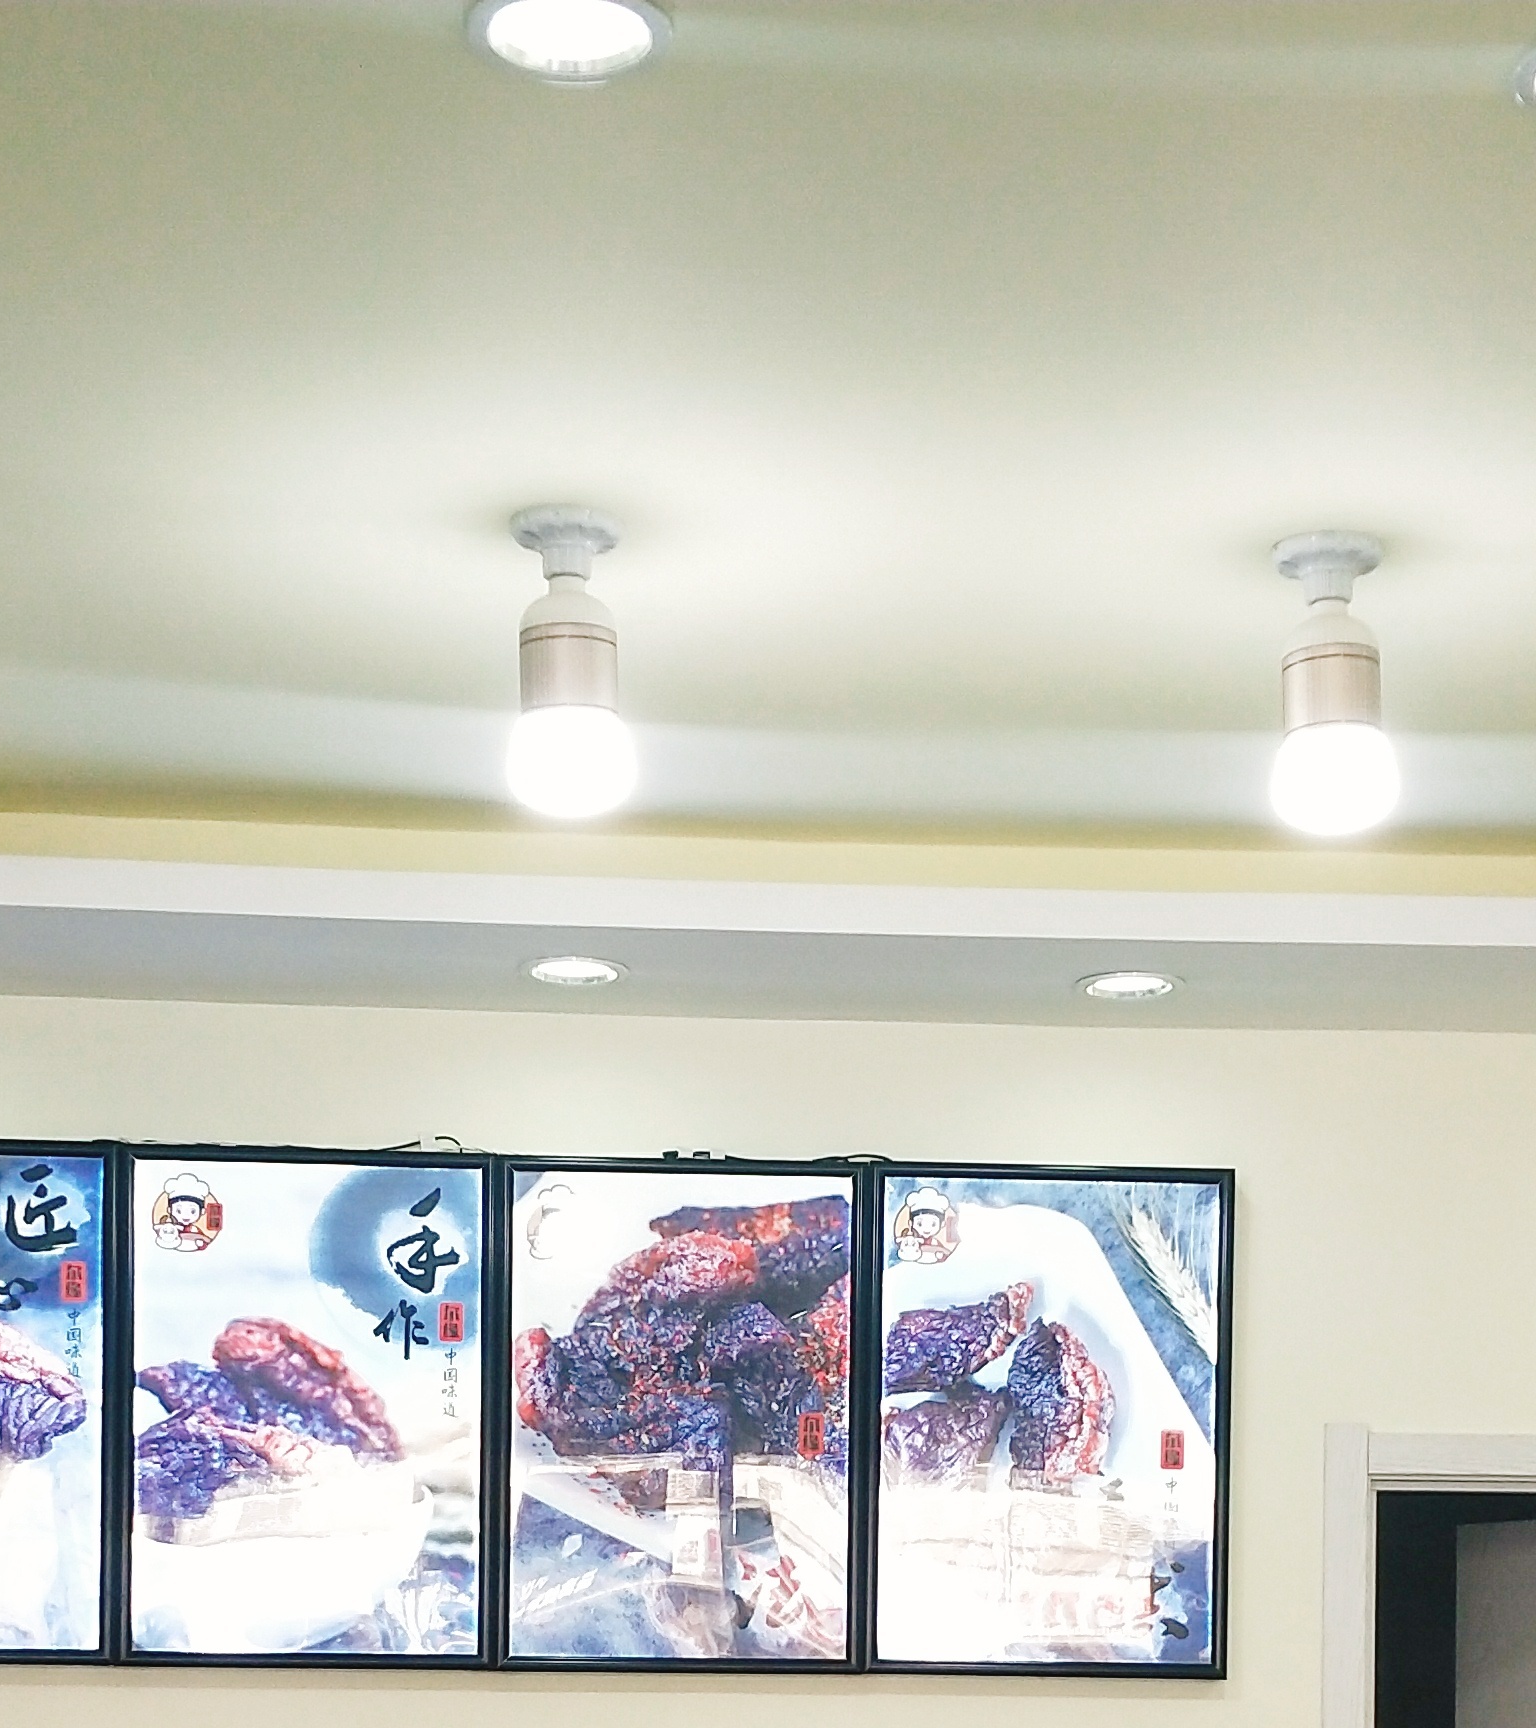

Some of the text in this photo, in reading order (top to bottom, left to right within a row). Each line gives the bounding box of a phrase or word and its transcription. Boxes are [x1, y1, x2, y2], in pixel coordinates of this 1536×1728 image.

[372, 1187, 461, 1361] 手作
[64, 1308, 83, 1379] 中国味道
[440, 1347, 459, 1418] 中国味道
